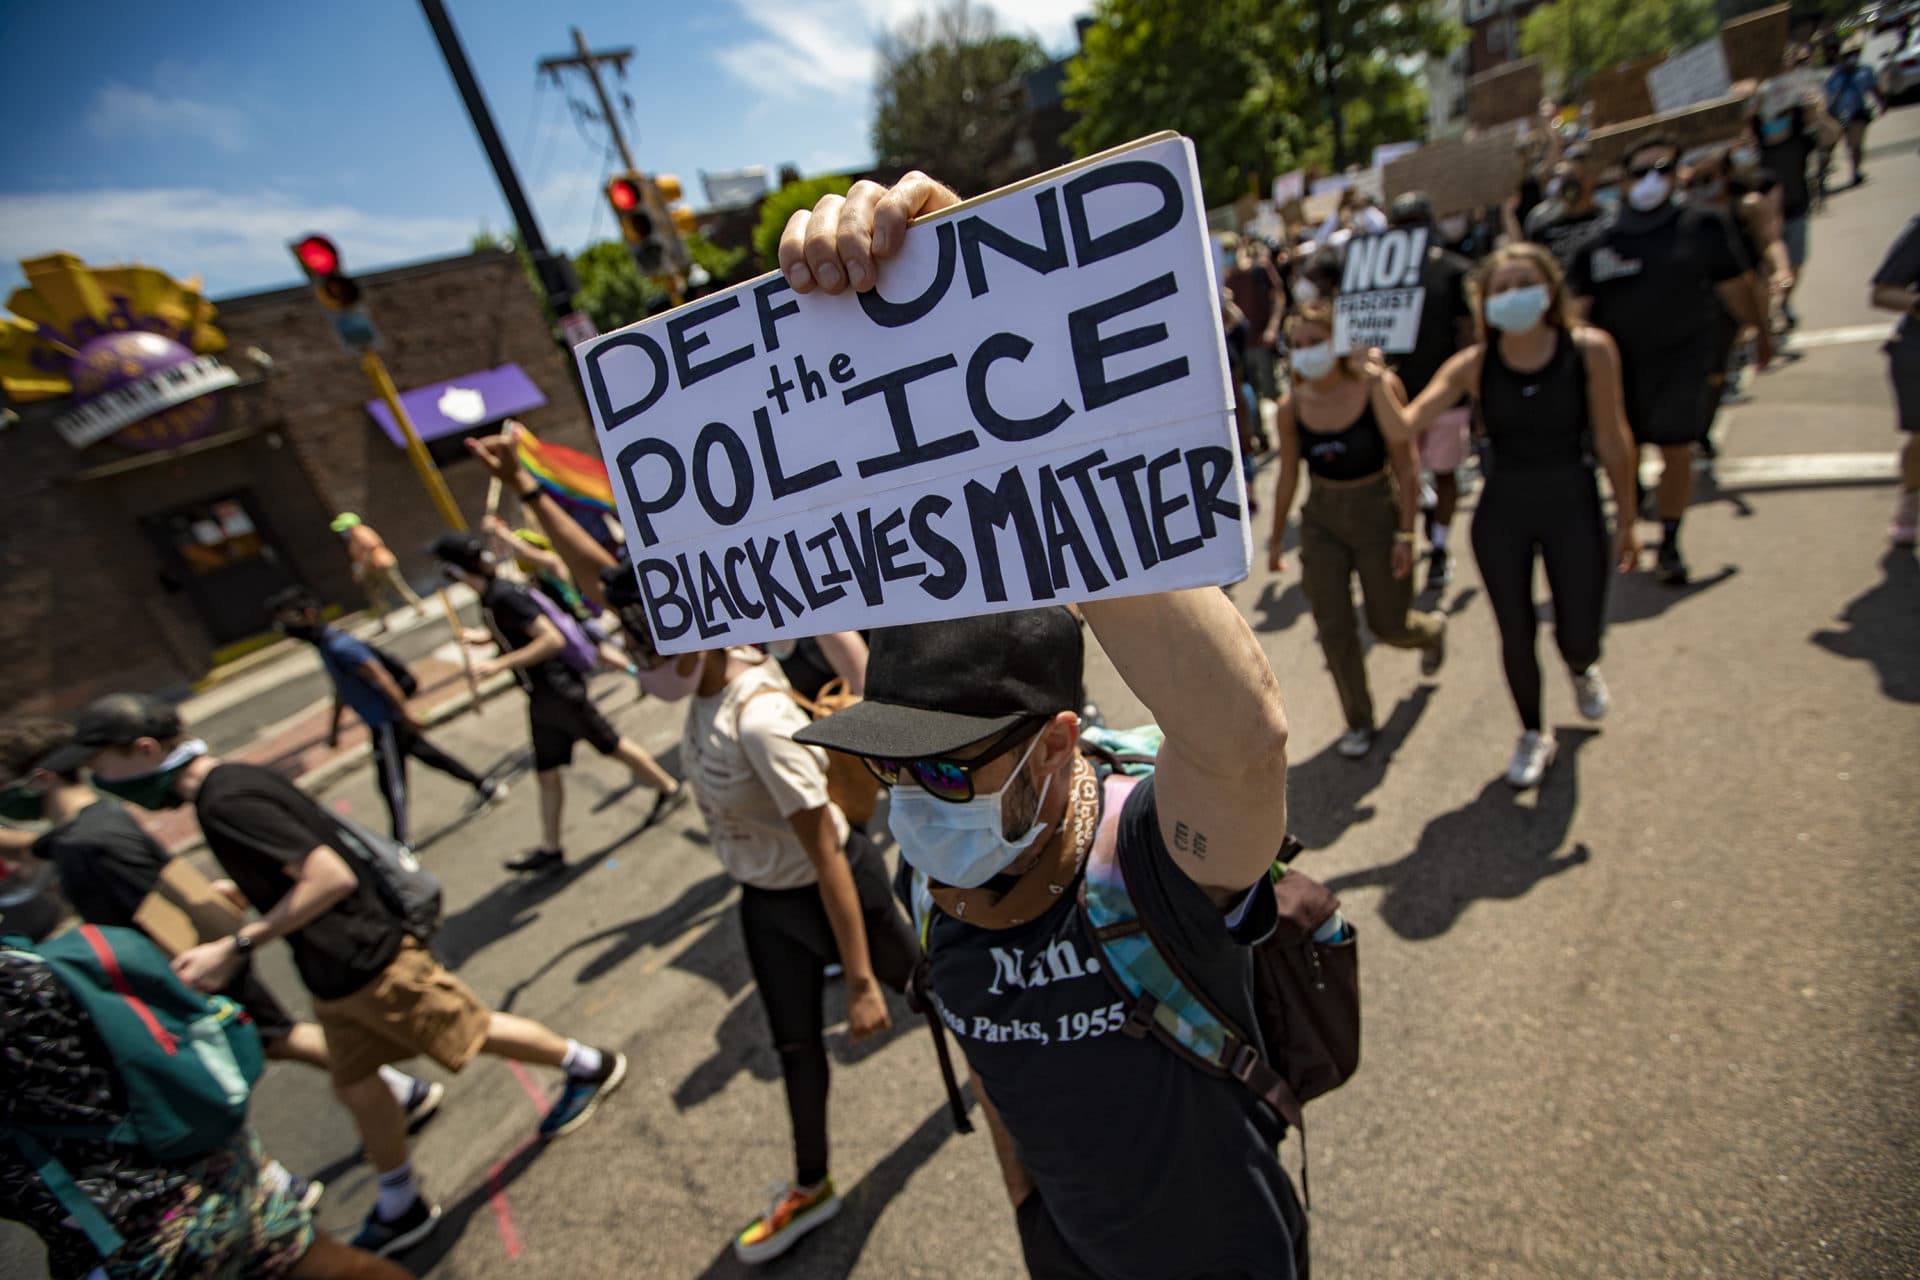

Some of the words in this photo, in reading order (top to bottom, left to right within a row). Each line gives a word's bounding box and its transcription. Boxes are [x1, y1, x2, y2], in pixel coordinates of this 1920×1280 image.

[584, 160, 1184, 432] DEFUND
[1341, 228, 1428, 294] NO!
[615, 270, 1190, 548] POLICE
[766, 352, 857, 415] the
[637, 537, 804, 642] BLACK
[784, 494, 968, 612] LIVES
[962, 445, 1241, 603] MATTER
[971, 1016, 1049, 1046] Parks,
[1057, 1001, 1127, 1042] 1955
